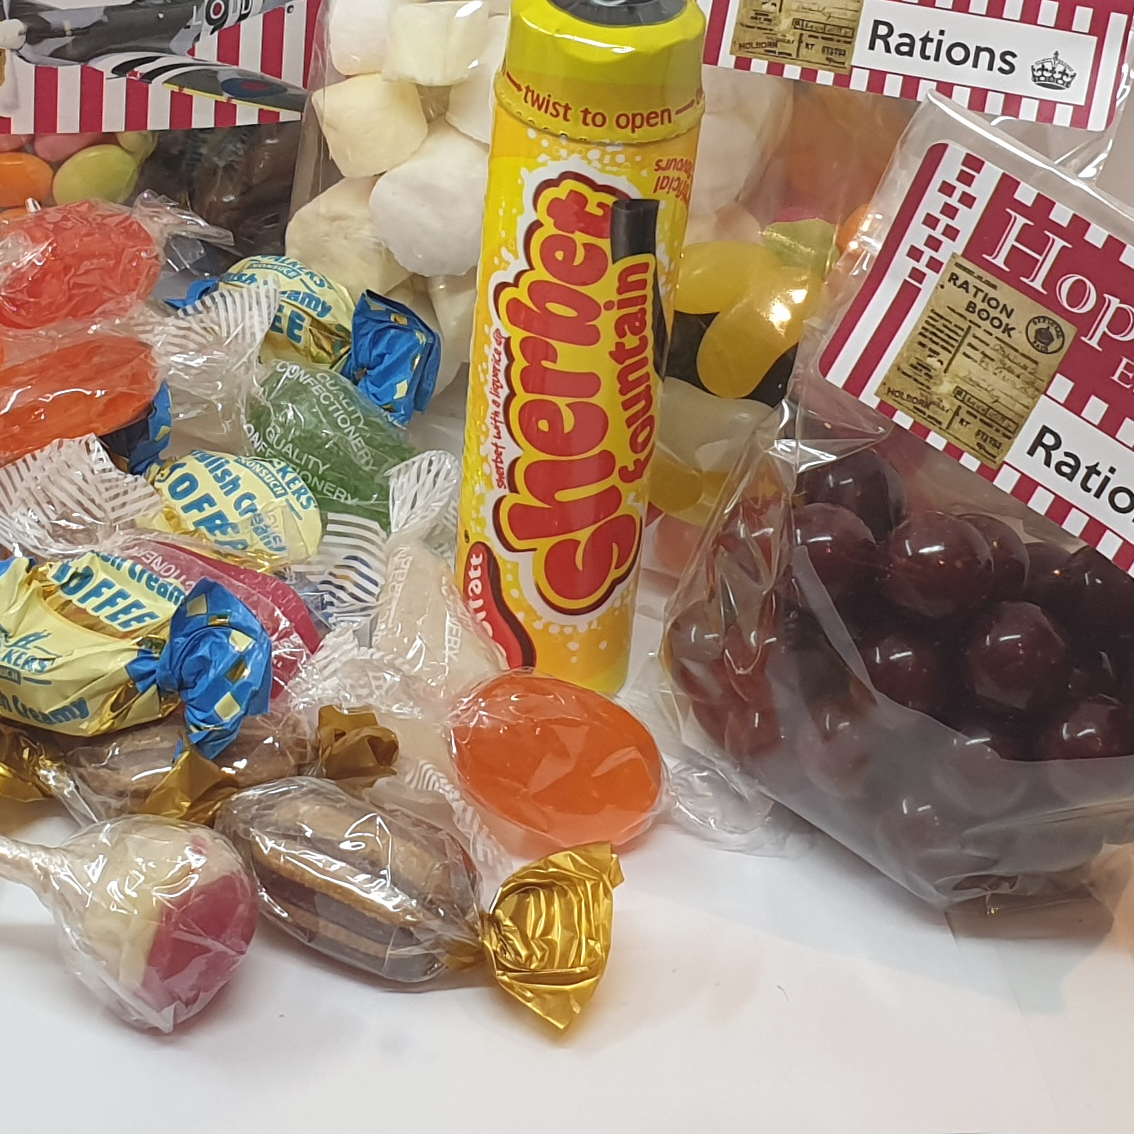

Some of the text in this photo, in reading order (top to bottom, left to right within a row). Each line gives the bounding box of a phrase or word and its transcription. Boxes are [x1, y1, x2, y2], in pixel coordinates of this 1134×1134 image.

[866, 18, 1019, 76] Rations
[522, 82, 673, 134] twist to open
[947, 271, 1015, 320] RATION
[965, 301, 1017, 340] BOOK
[488, 348, 504, 399] liquorice
[266, 424, 332, 476] QUALITY
[488, 410, 505, 440] with
[490, 440, 507, 491] sherbet
[50, 561, 162, 630] TOFFEE
[127, 563, 185, 607] Cream
